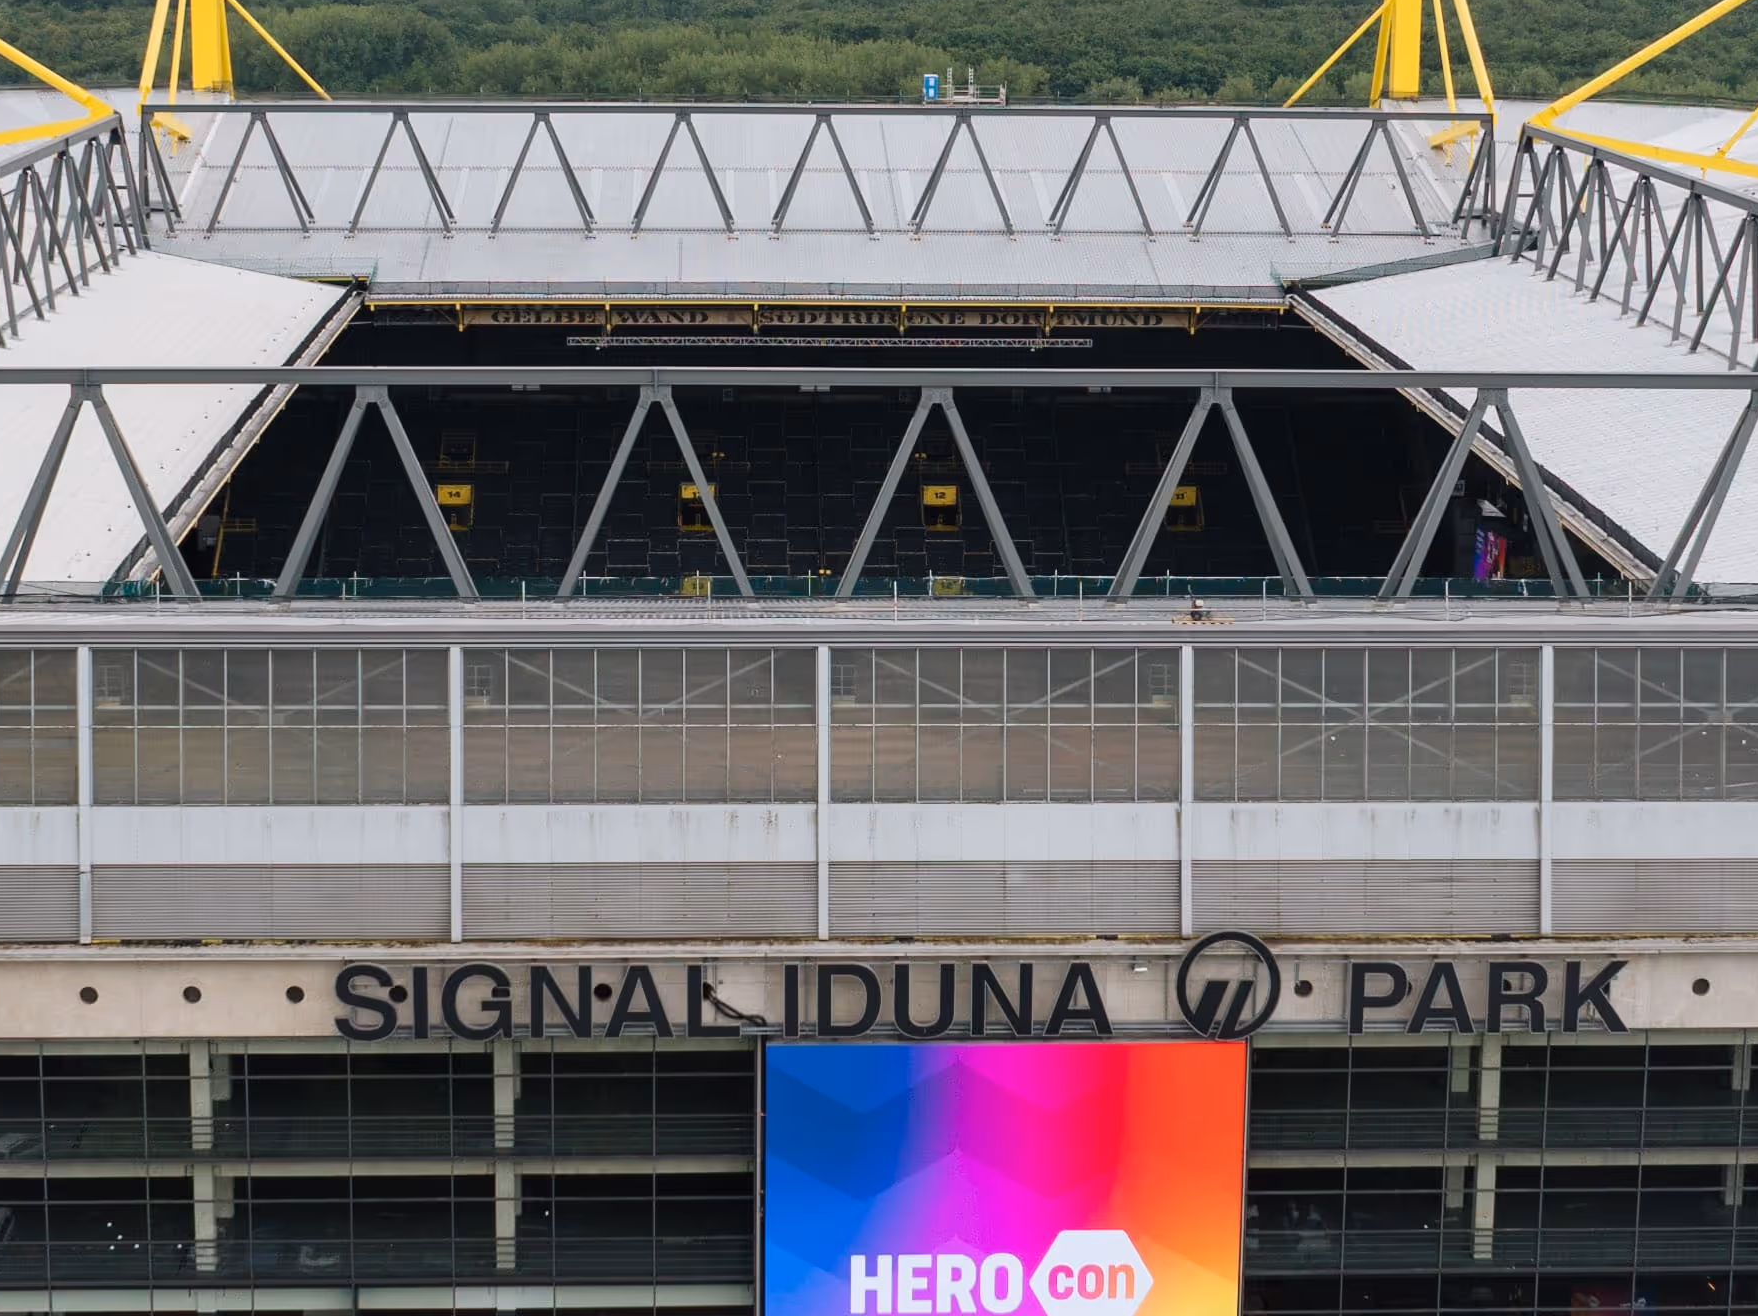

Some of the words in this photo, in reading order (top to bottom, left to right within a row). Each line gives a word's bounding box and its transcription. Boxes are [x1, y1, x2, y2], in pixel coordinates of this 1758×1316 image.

[491, 310, 595, 324] GELBE
[616, 310, 709, 324] WAND
[334, 962, 741, 1041] SIGNAL
[782, 962, 1114, 1038] IDUNA
[1347, 960, 1630, 1035] PARK
[849, 1253, 1023, 1314] HERO
[1047, 1263, 1134, 1300] con
